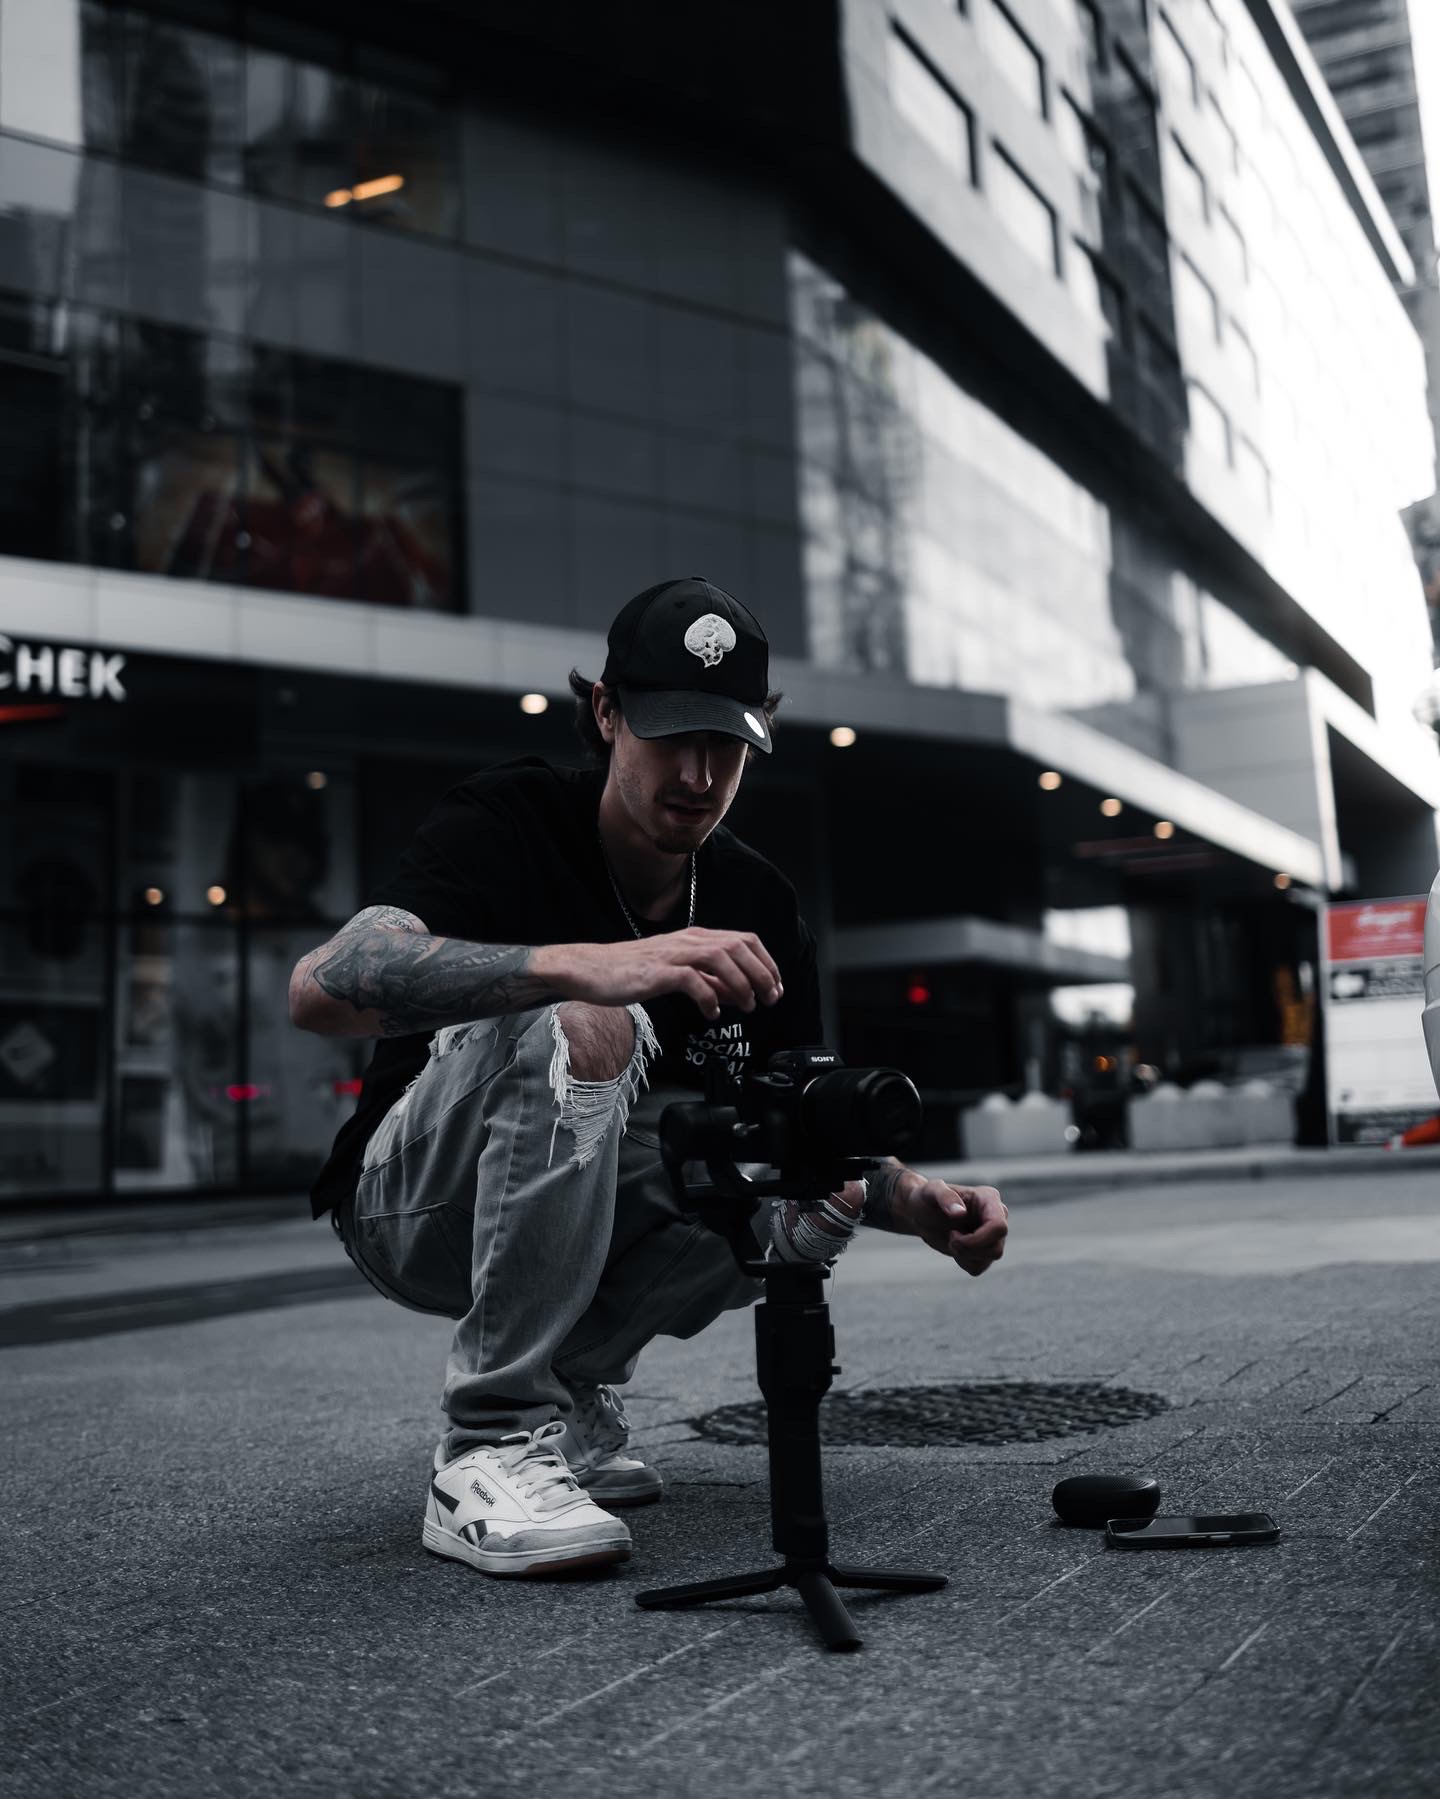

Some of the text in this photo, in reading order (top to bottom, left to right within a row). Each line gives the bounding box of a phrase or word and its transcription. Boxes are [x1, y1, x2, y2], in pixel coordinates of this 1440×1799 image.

[704, 1023, 742, 1039] ANTI
[688, 1034, 751, 1057] SOCIAL
[472, 1482, 495, 1507] Reebok
